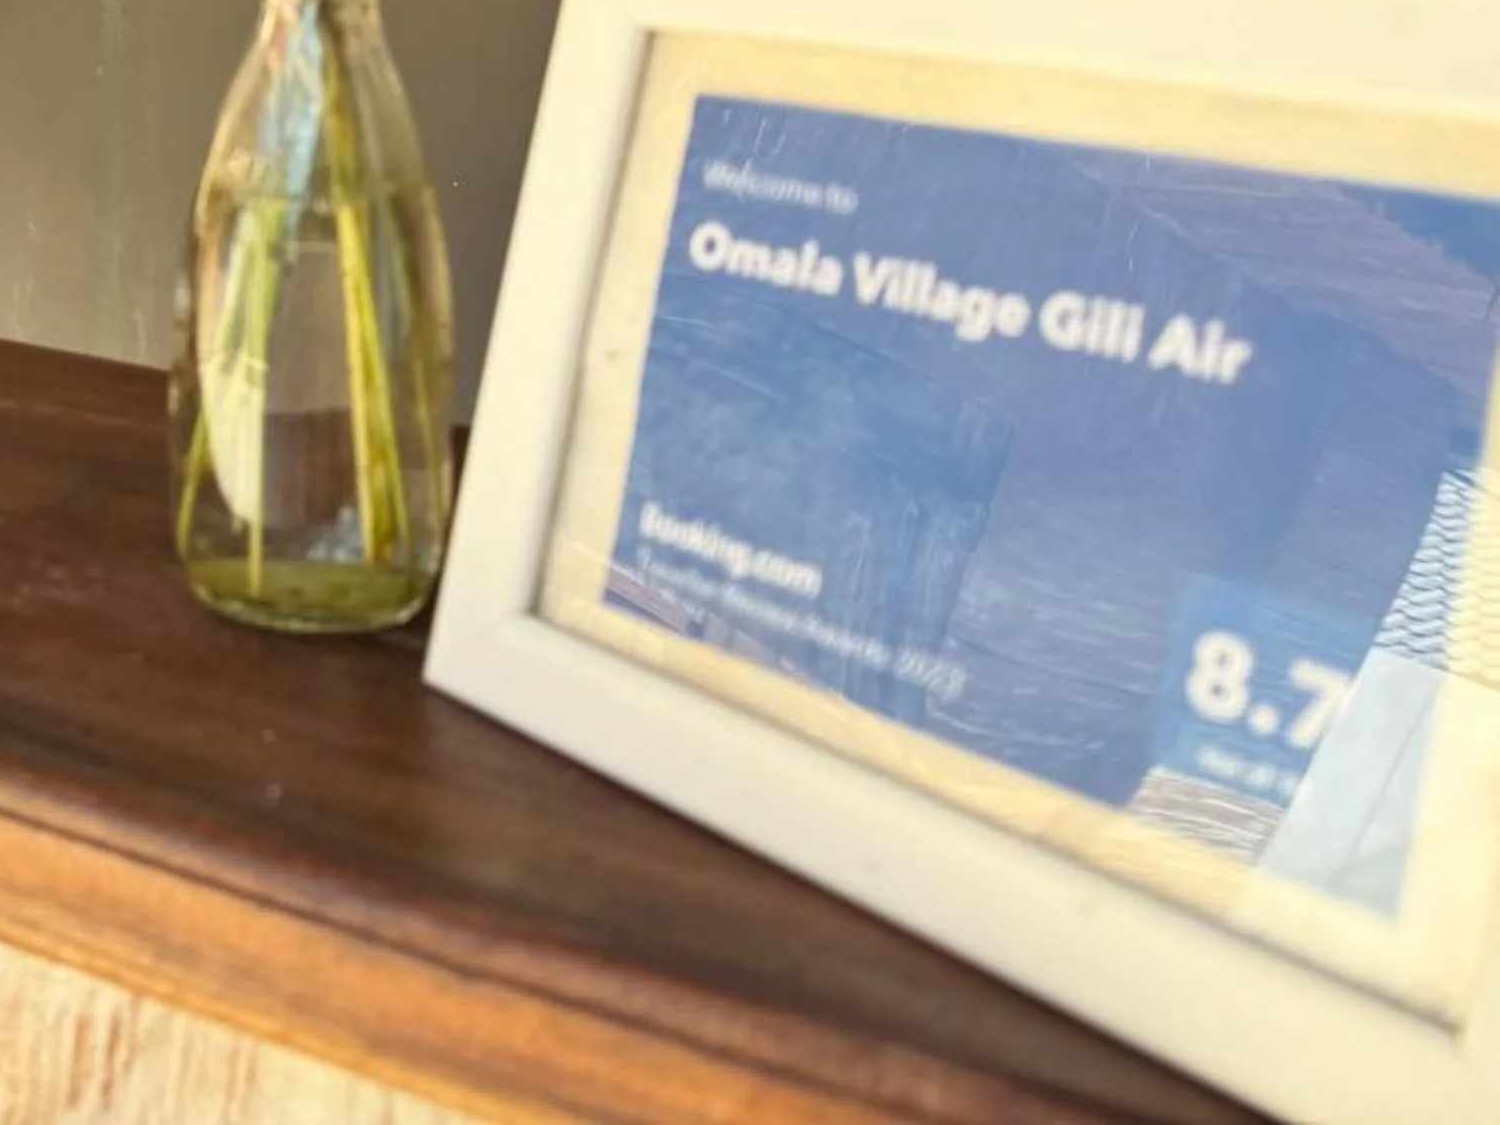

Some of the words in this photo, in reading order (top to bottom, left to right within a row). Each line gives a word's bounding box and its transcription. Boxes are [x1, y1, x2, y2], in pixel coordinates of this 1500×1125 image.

[688, 220, 843, 297] Omala
[853, 251, 1031, 342] Village
[1147, 311, 1252, 385] Air
[1186, 629, 1354, 750] 8.7
